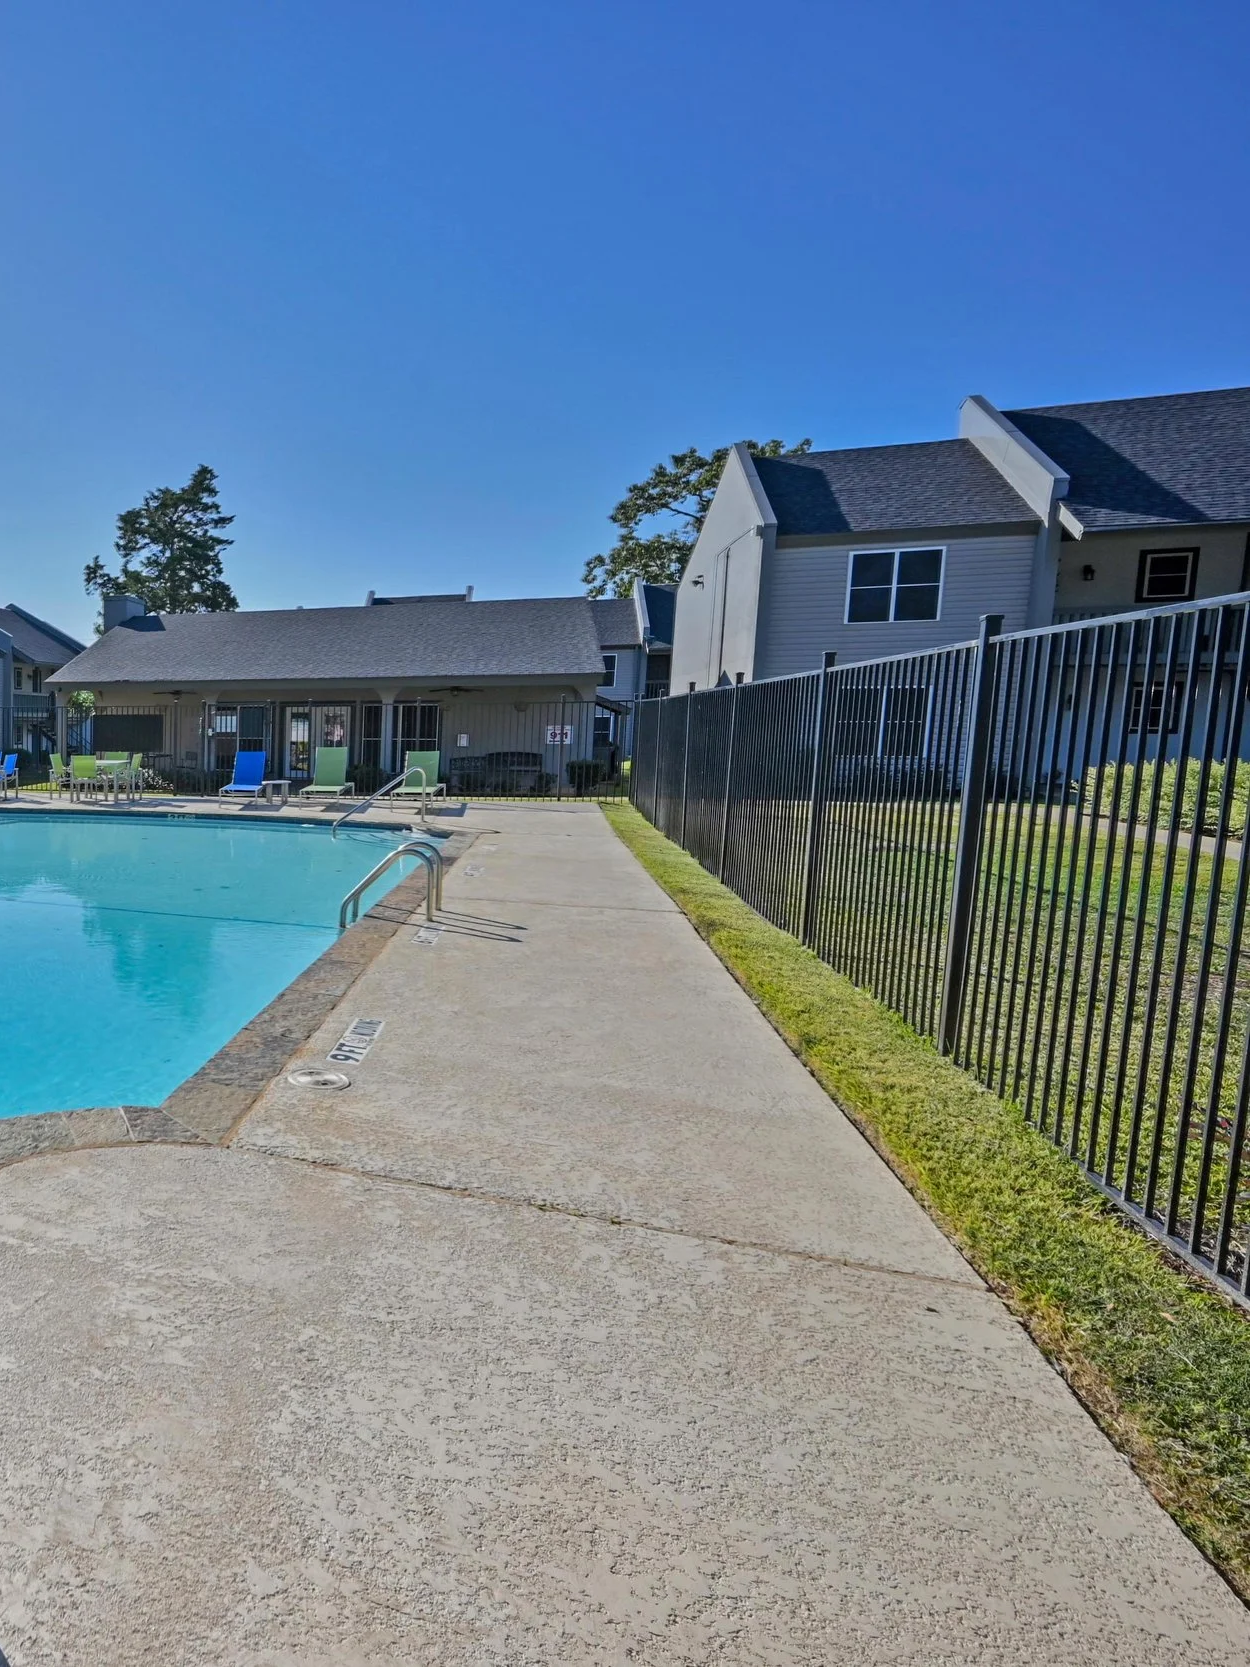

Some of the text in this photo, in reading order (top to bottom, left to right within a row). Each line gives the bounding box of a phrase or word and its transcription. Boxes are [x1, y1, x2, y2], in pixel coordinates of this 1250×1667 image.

[550, 731, 568, 740] 91
[335, 1042, 367, 1055] FT
[330, 1053, 360, 1063] 9
